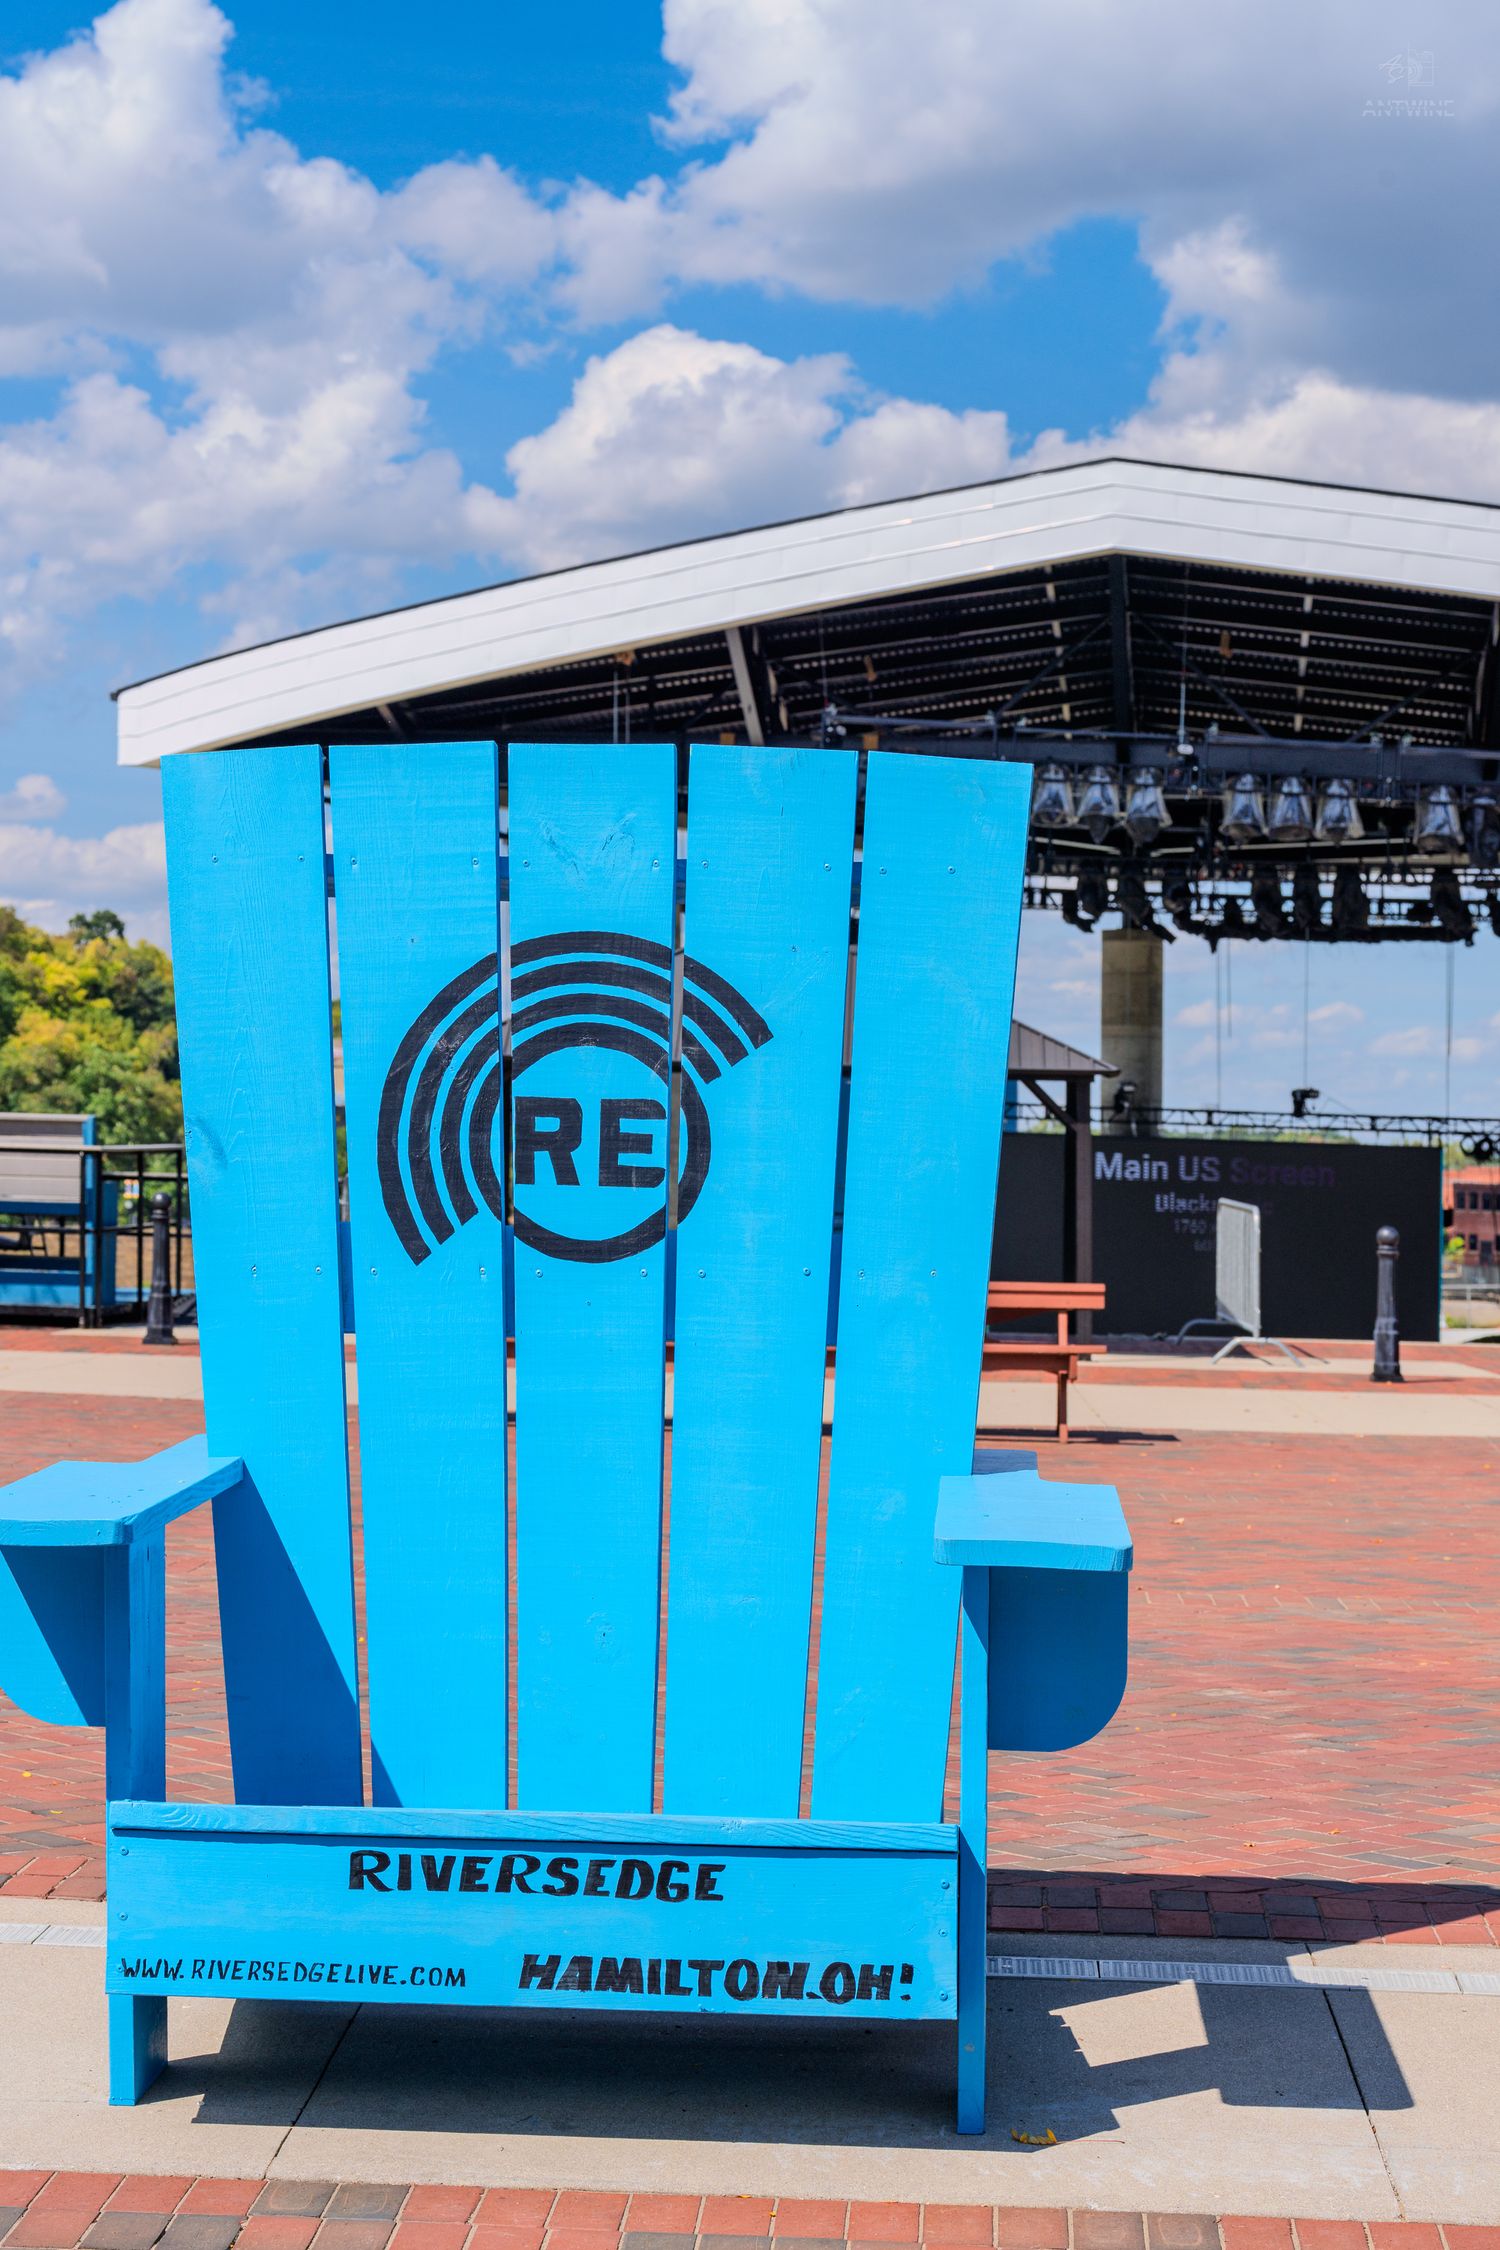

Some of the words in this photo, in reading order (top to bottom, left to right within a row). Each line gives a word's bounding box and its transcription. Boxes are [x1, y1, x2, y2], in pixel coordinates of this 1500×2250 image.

[515, 1097, 666, 1188] RE
[1094, 1151, 1169, 1182] Main
[1178, 1155, 1221, 1182] US
[1231, 1157, 1336, 1187] Screen
[348, 1849, 727, 1903] RIVERSEDGE
[518, 1953, 914, 2004] HAMILTON.OH!
